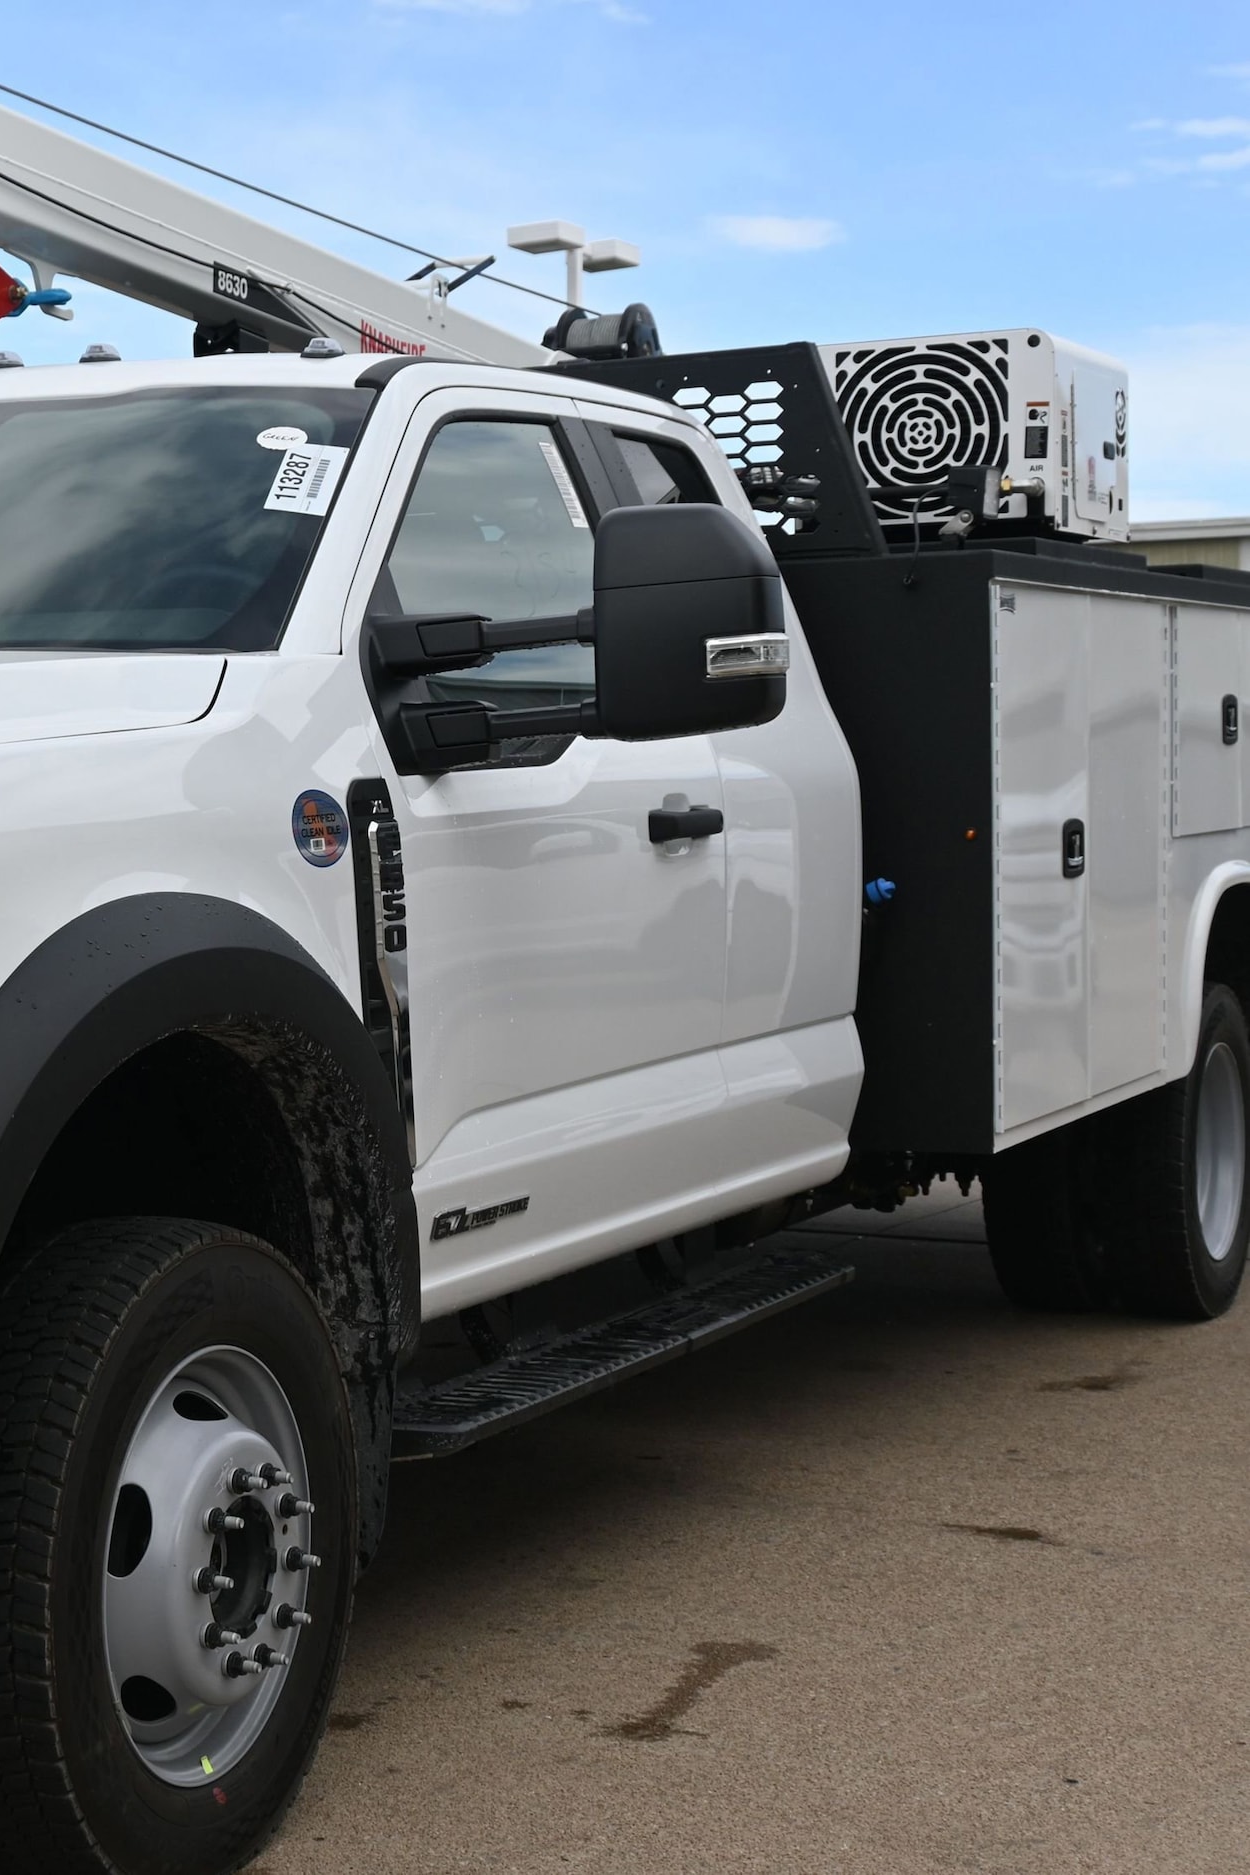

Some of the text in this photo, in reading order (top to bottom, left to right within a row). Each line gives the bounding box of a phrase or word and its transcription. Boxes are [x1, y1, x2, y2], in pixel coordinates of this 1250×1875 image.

[217, 270, 248, 299] 8630
[1029, 464, 1044, 472] AIR
[274, 452, 312, 500] 113287
[302, 813, 336, 825] CERTIFIED
[301, 825, 342, 838] CLEAN IDLE
